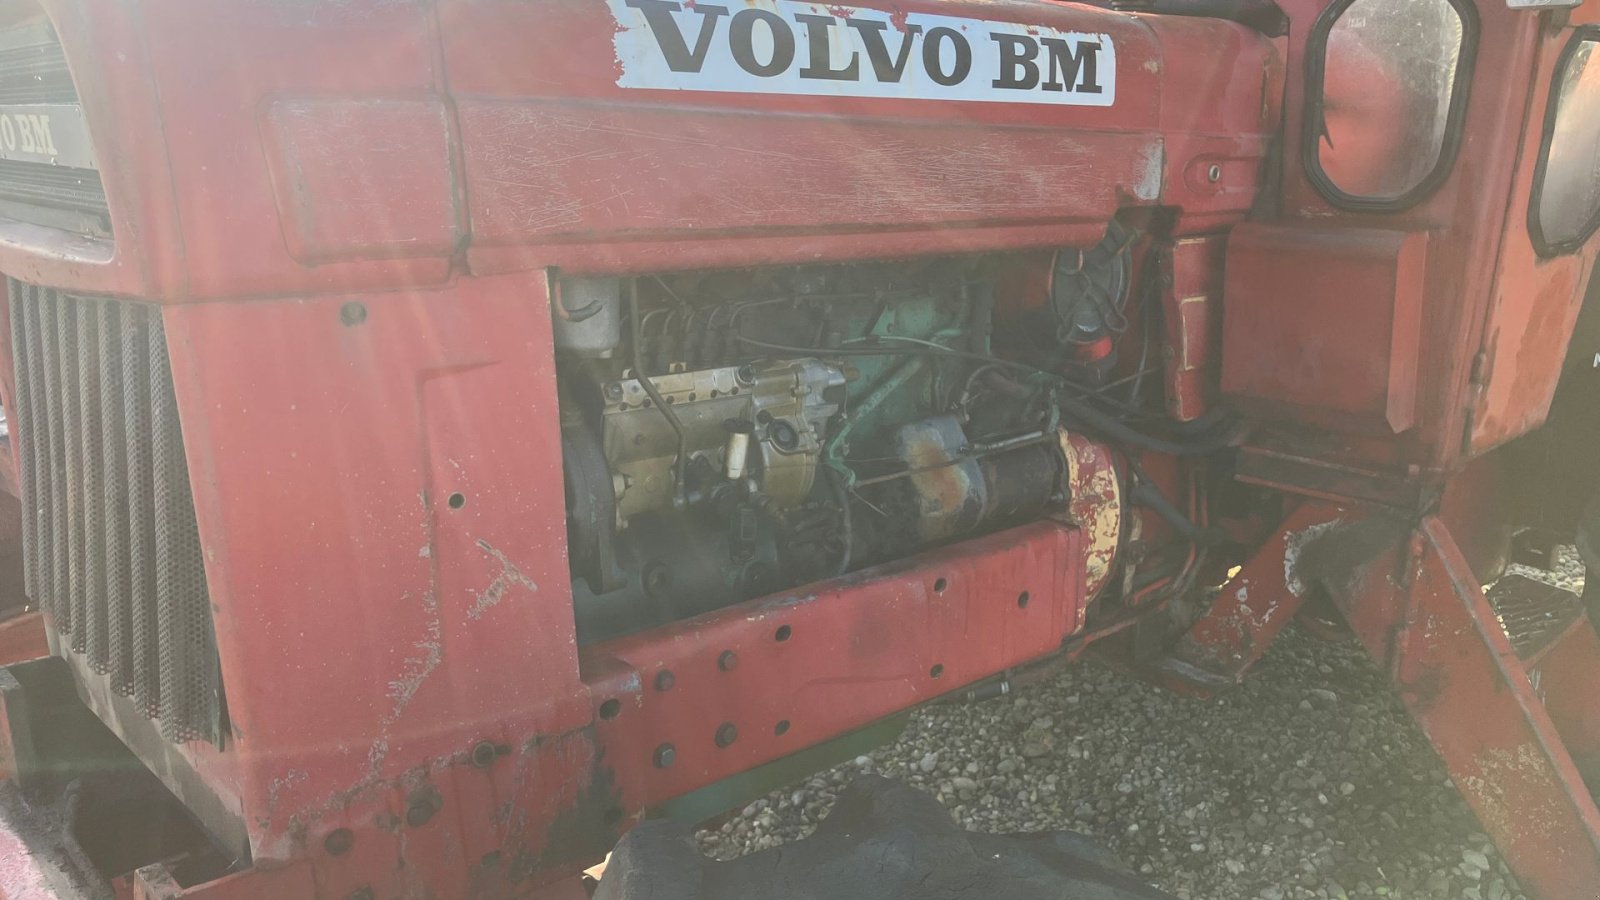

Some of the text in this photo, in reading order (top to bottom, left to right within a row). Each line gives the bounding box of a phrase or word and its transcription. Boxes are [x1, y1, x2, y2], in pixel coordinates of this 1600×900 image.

[625, 0, 1103, 94] VOLVO BM
[14, 114, 58, 155] BM
